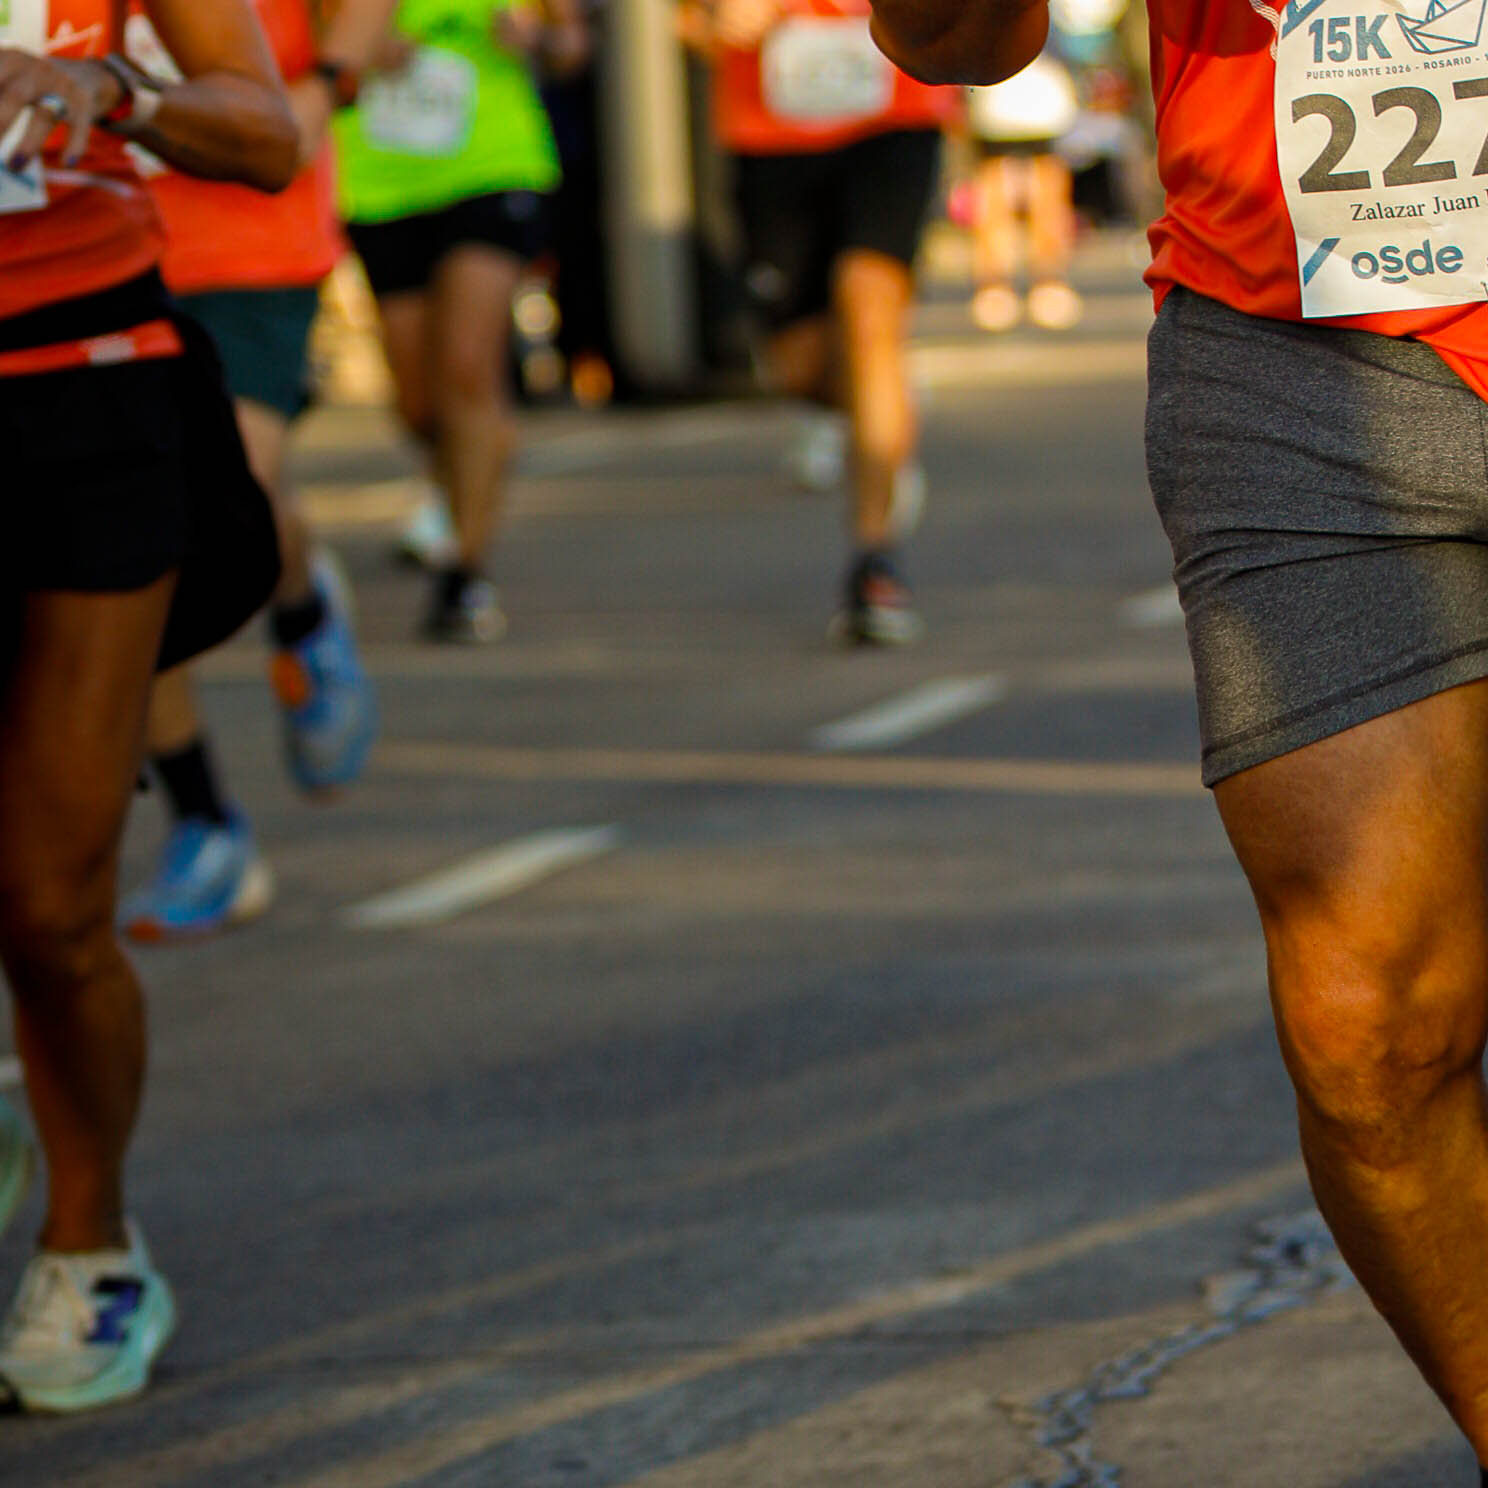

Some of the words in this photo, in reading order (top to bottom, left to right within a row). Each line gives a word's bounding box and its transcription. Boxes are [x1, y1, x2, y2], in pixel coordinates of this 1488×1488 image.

[1308, 14, 1393, 63] 15K
[1306, 68, 1344, 80] PUERTO
[1347, 66, 1381, 78] NORTE
[1384, 62, 1412, 75] 2026
[1423, 56, 1472, 70] ROSARIO
[1350, 202, 1426, 222] Zalazar
[1433, 195, 1481, 215] Juan
[1351, 239, 1464, 281] osde
